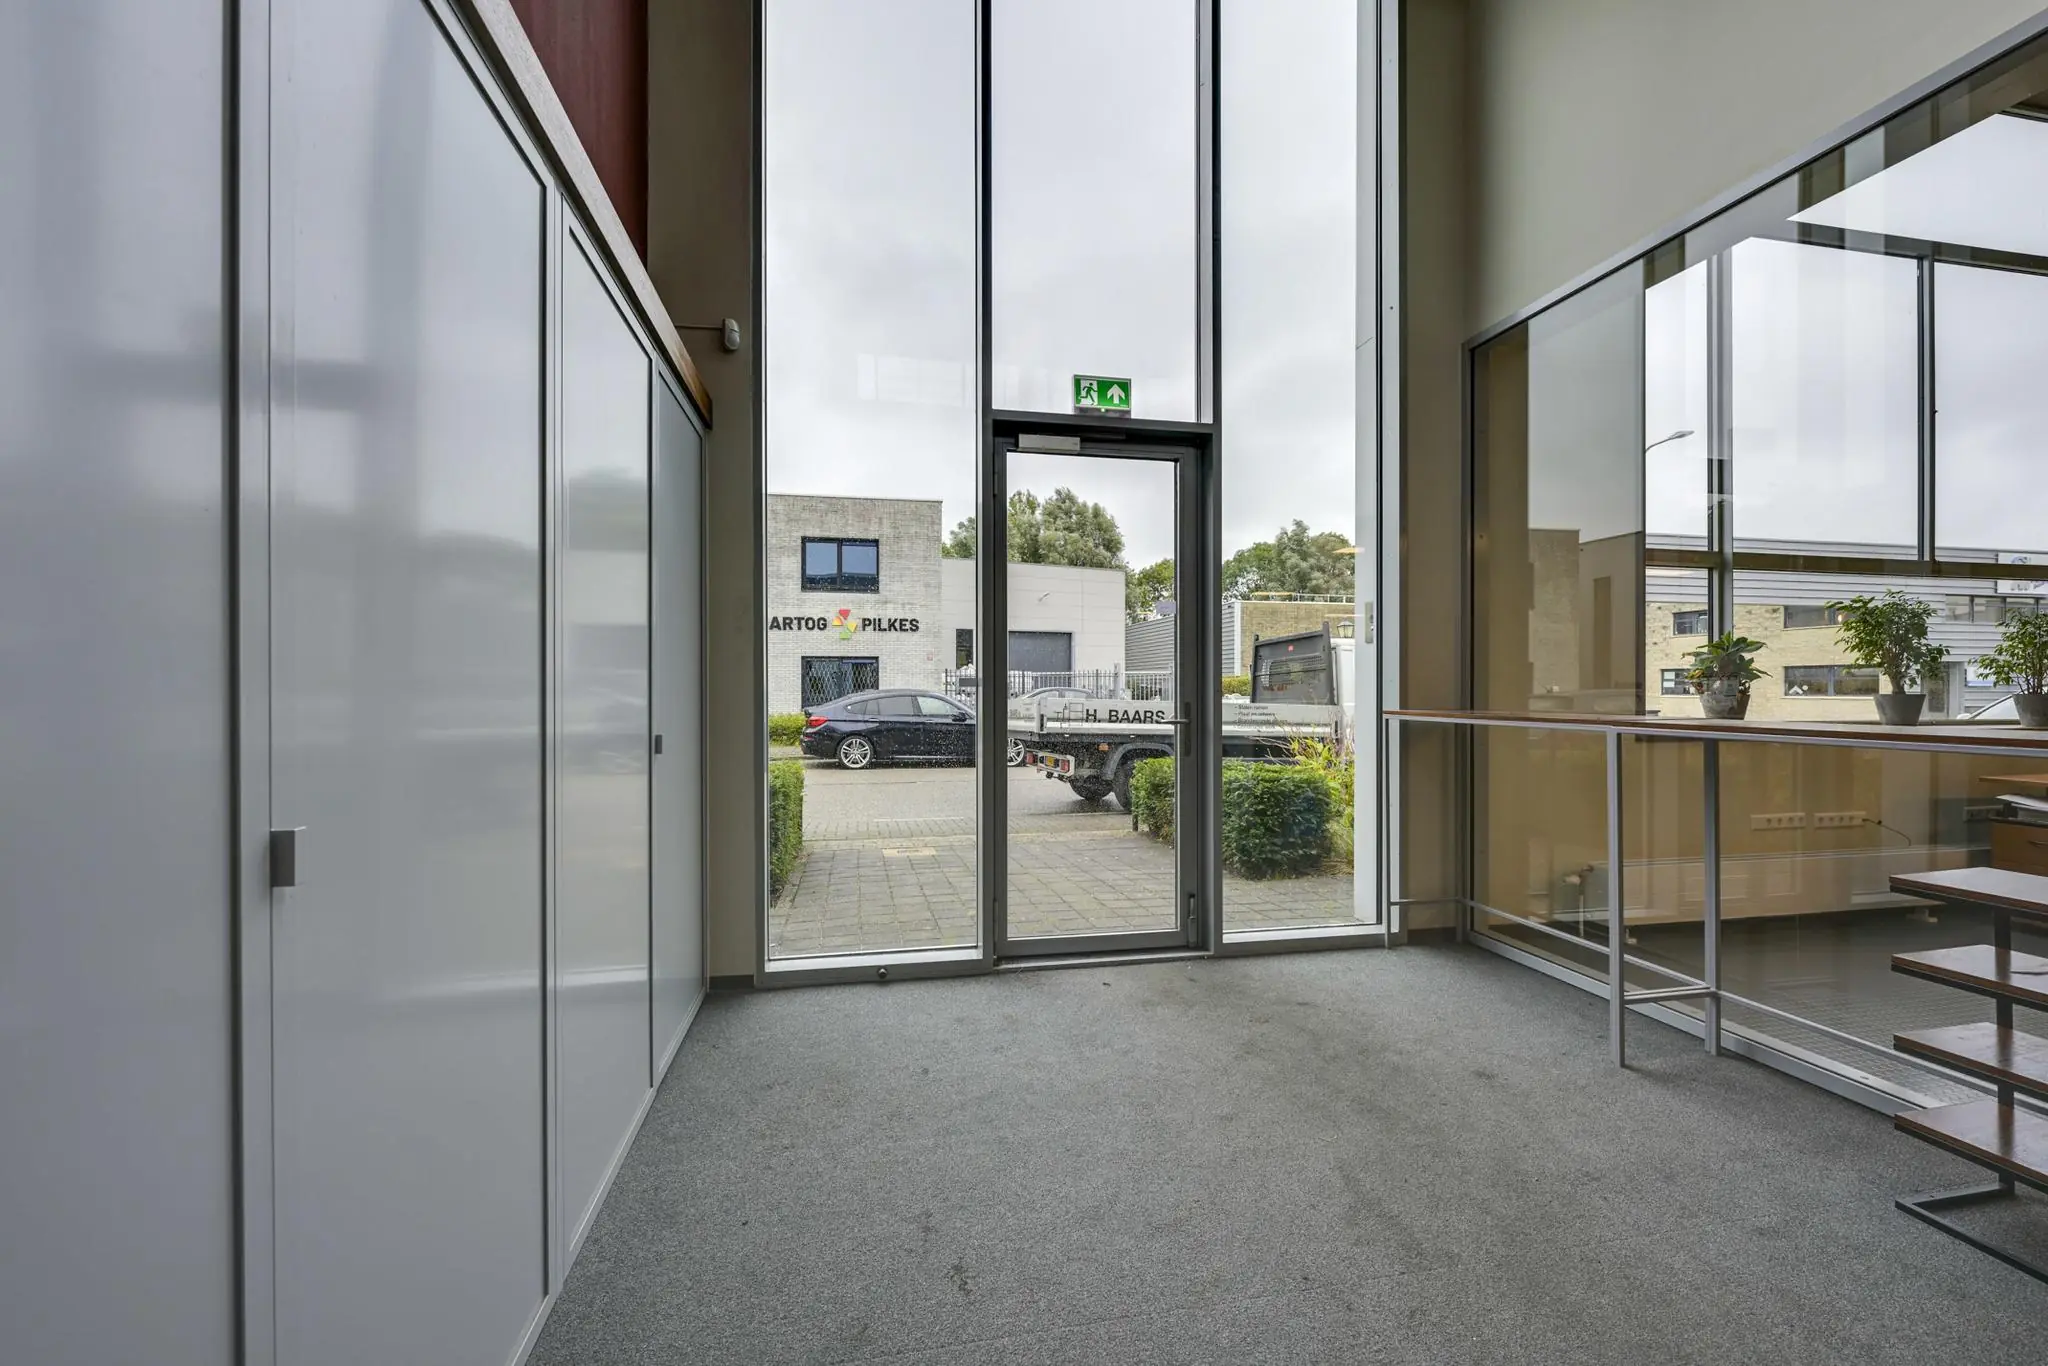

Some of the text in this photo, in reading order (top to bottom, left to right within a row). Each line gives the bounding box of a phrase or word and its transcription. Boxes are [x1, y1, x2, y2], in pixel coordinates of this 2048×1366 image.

[769, 616, 920, 632] ARTOG PILKES
[1085, 708, 1166, 724] H. BAARS
